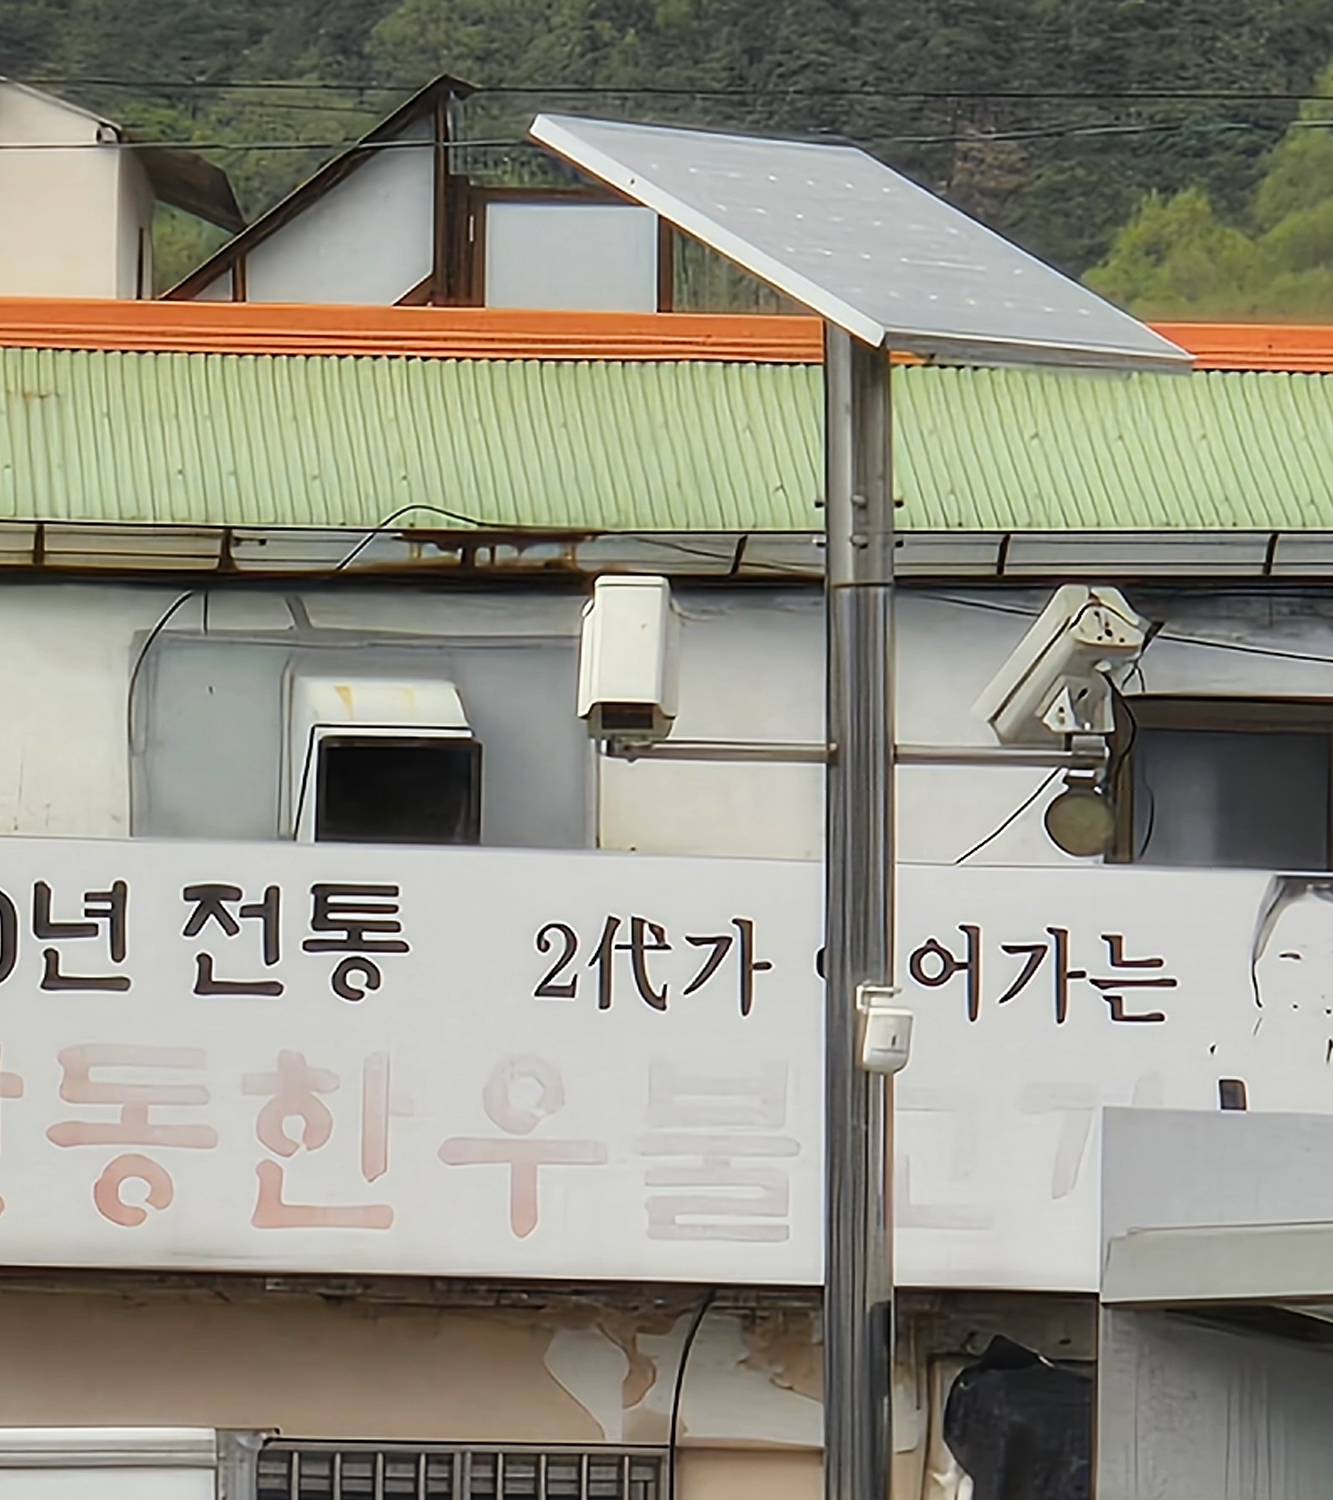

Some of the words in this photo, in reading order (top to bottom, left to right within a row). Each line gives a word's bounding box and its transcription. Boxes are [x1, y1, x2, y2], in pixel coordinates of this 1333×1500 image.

[181, 880, 412, 1002] 전통
[533, 914, 774, 1018] 2代가
[815, 922, 1181, 1025] 어가는
